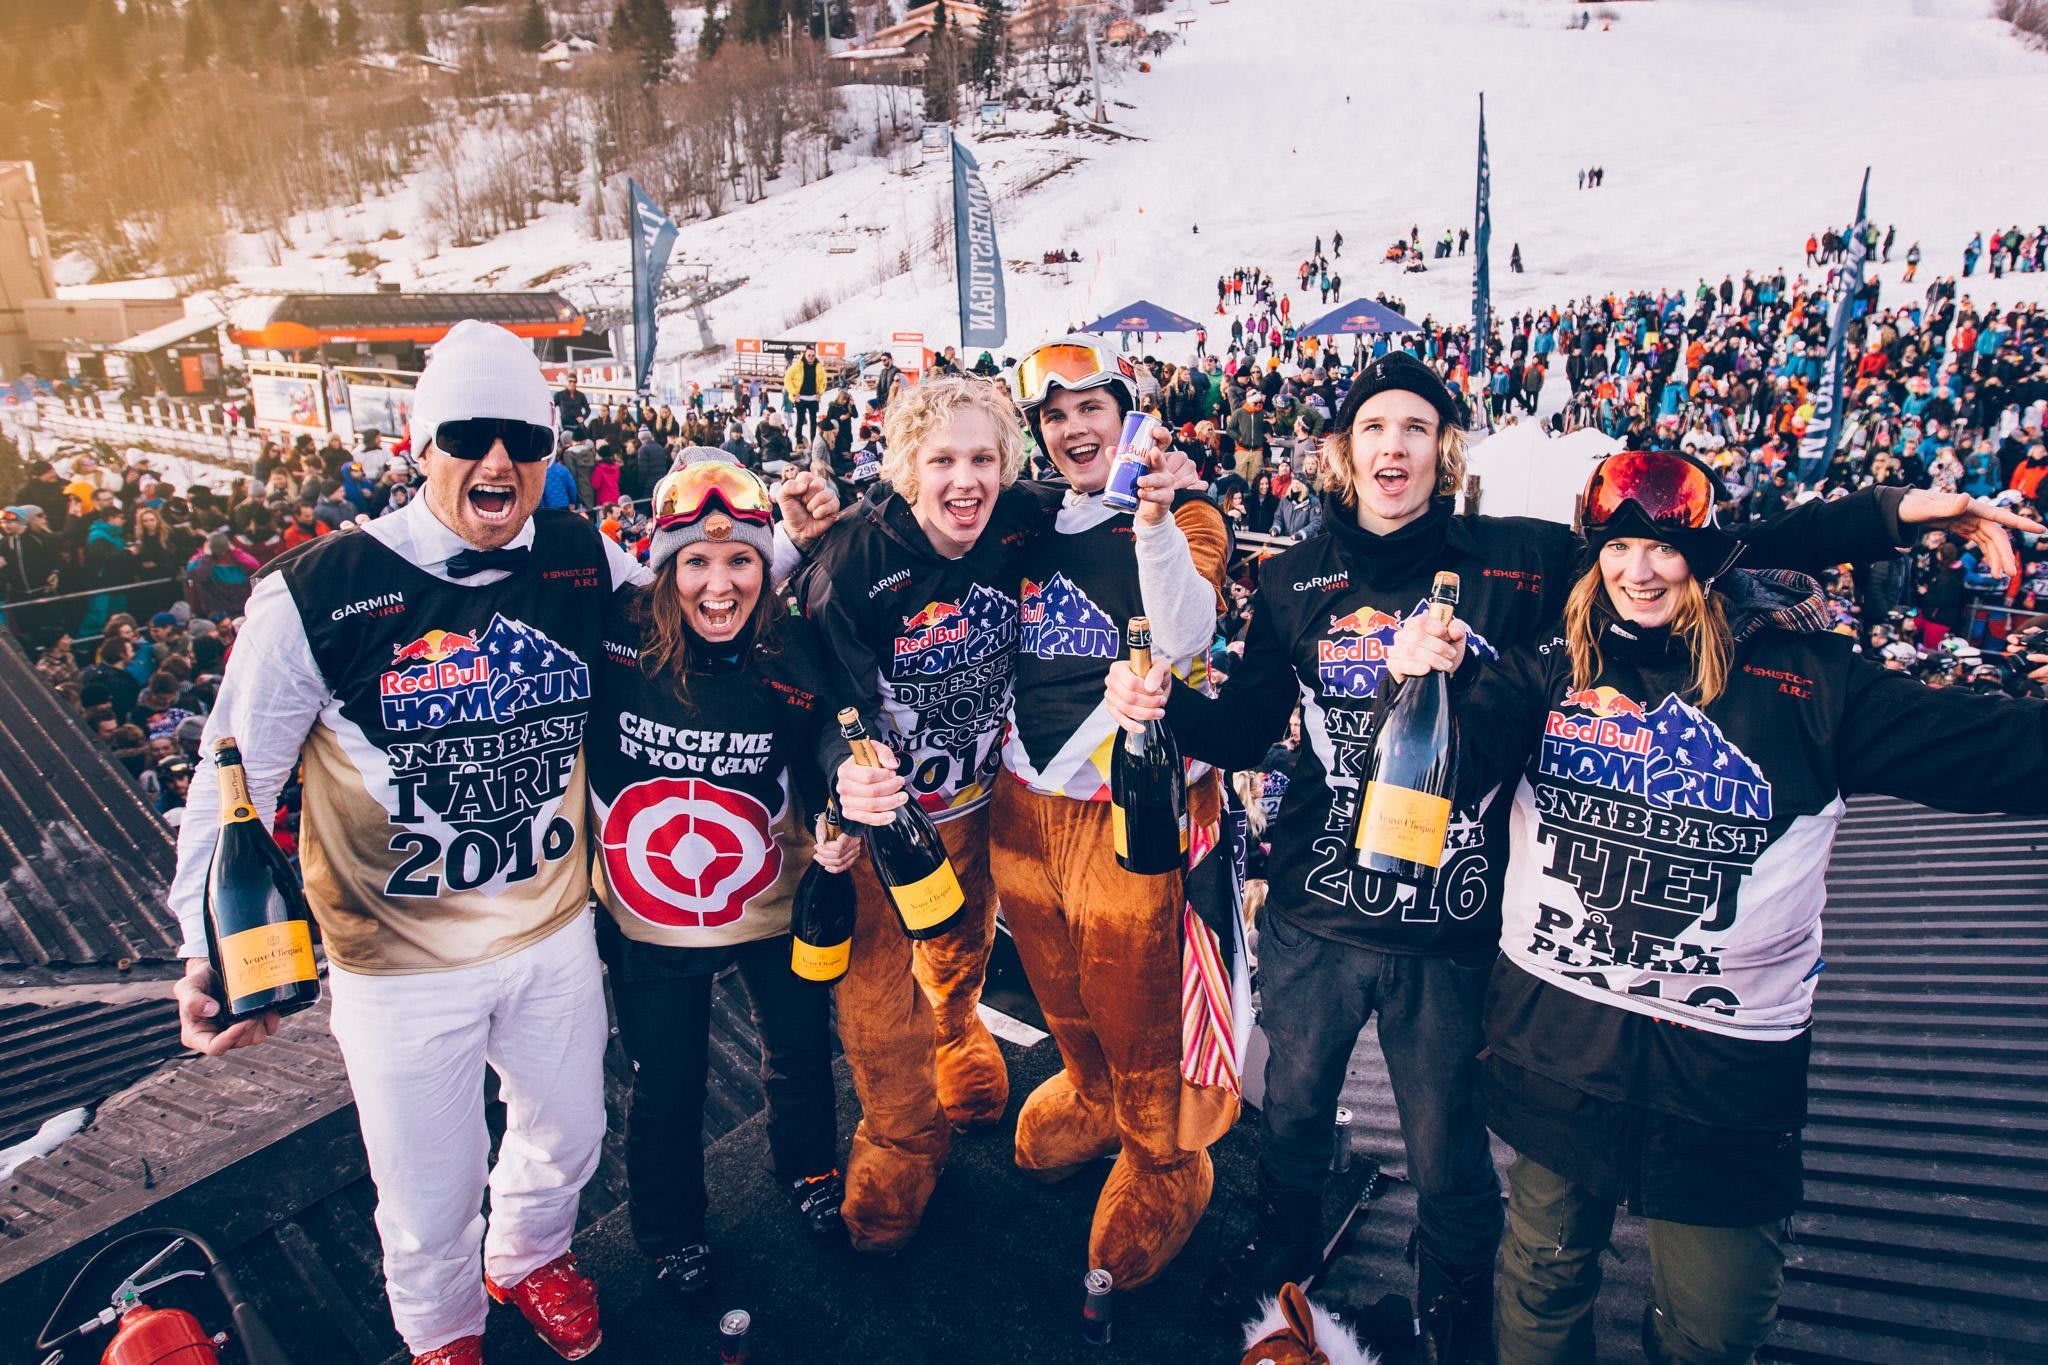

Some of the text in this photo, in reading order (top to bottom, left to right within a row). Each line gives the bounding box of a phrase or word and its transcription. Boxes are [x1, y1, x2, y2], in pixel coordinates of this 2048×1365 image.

[857, 464, 877, 476] 296
[1293, 570, 1349, 592] GARMIN
[1321, 581, 1350, 593] VIRB
[331, 591, 404, 622] GARMIN
[369, 604, 406, 619] VIRB
[602, 640, 638, 659] RMIN
[895, 617, 969, 656] Red Bull
[1318, 637, 1364, 663] Red
[381, 655, 490, 696] Red Bull
[908, 676, 1008, 737] FOR
[387, 711, 589, 771] SNABBAST
[619, 711, 773, 754] CATCH ME
[1545, 711, 1654, 755] Red Bull
[619, 734, 644, 760] IF
[643, 748, 706, 773] YOU
[1535, 784, 1768, 856] SNABBAST
[1536, 822, 1753, 933] TJEJ
[1534, 901, 1617, 956] PÅ
[242, 953, 271, 966] Veuve
